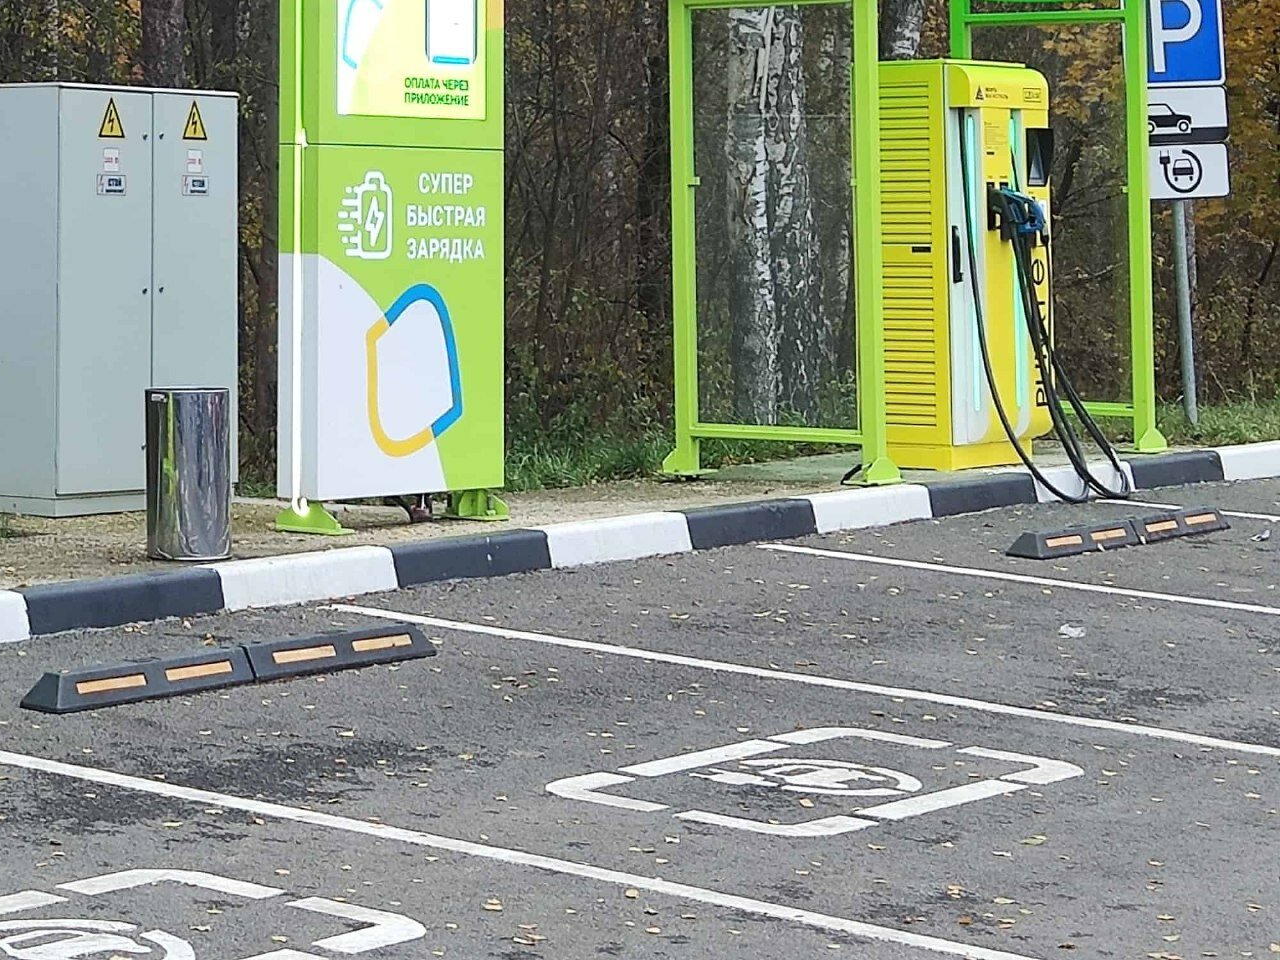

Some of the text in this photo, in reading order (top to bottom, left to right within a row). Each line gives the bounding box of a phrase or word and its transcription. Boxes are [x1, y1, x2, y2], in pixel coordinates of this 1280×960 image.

[404, 77, 469, 91] ОПЛАТА ЧЕРЕЗ
[404, 92, 469, 106] ПРИЛОЖЕНИЕ
[418, 172, 474, 195] СУПЕР
[406, 204, 486, 227] БЫСТРАЯ
[406, 237, 486, 264] ЗАРЯДКА
